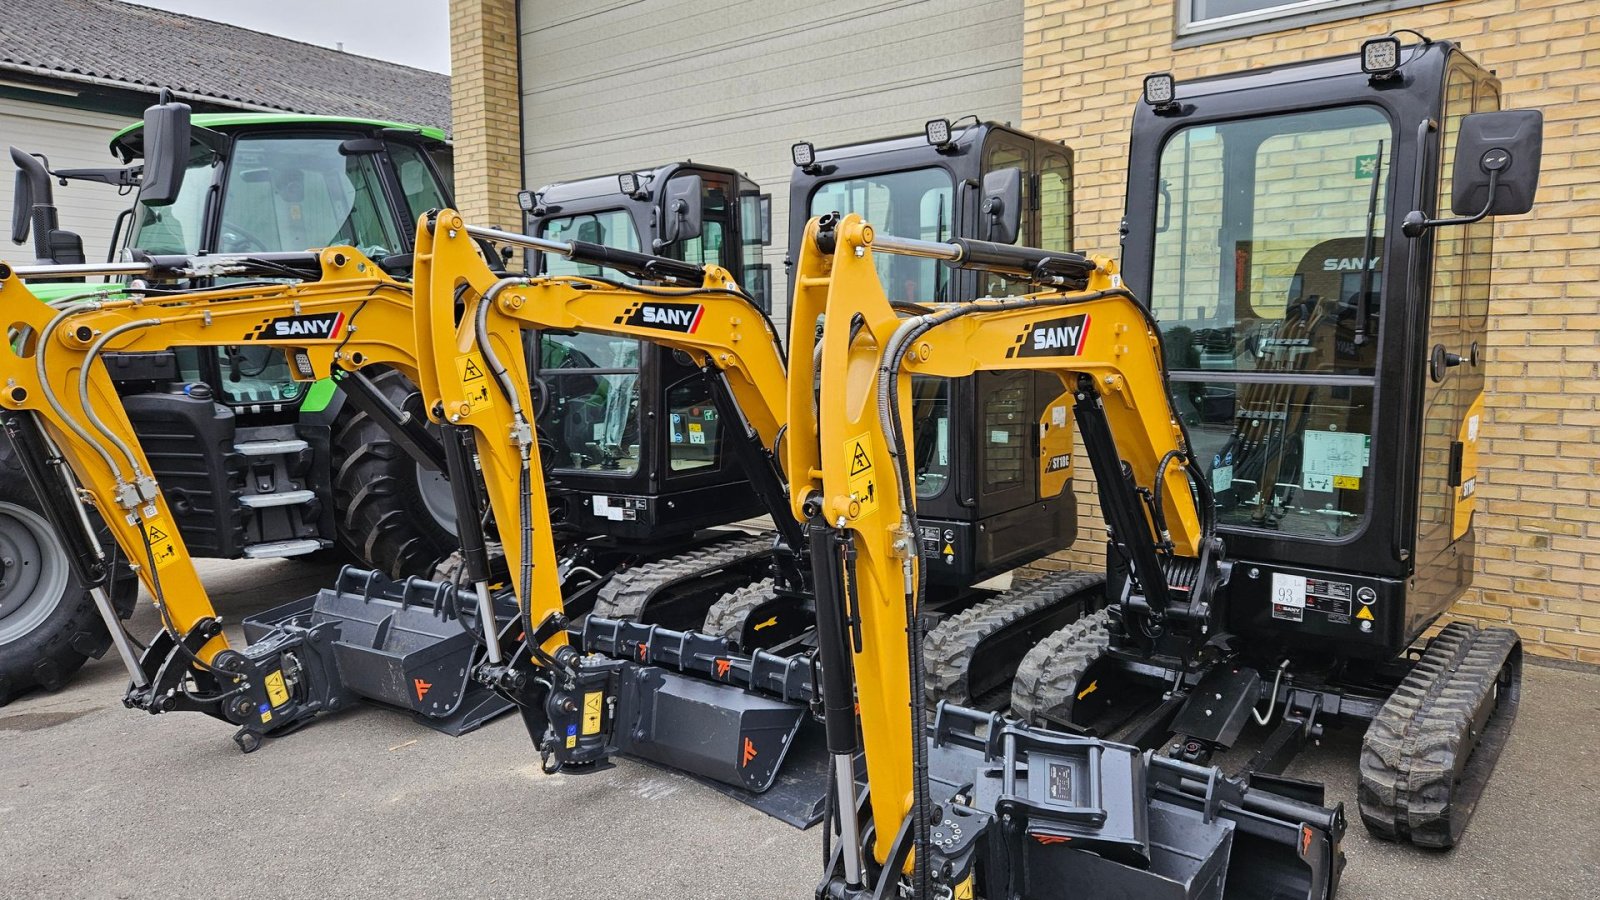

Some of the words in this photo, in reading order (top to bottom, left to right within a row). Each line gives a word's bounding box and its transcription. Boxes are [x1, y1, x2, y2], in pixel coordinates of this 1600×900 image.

[1323, 256, 1380, 271] SANY
[642, 306, 692, 326] SANY
[275, 319, 331, 336] SANY
[1033, 326, 1080, 350] SANY
[1278, 587, 1293, 603] 93
